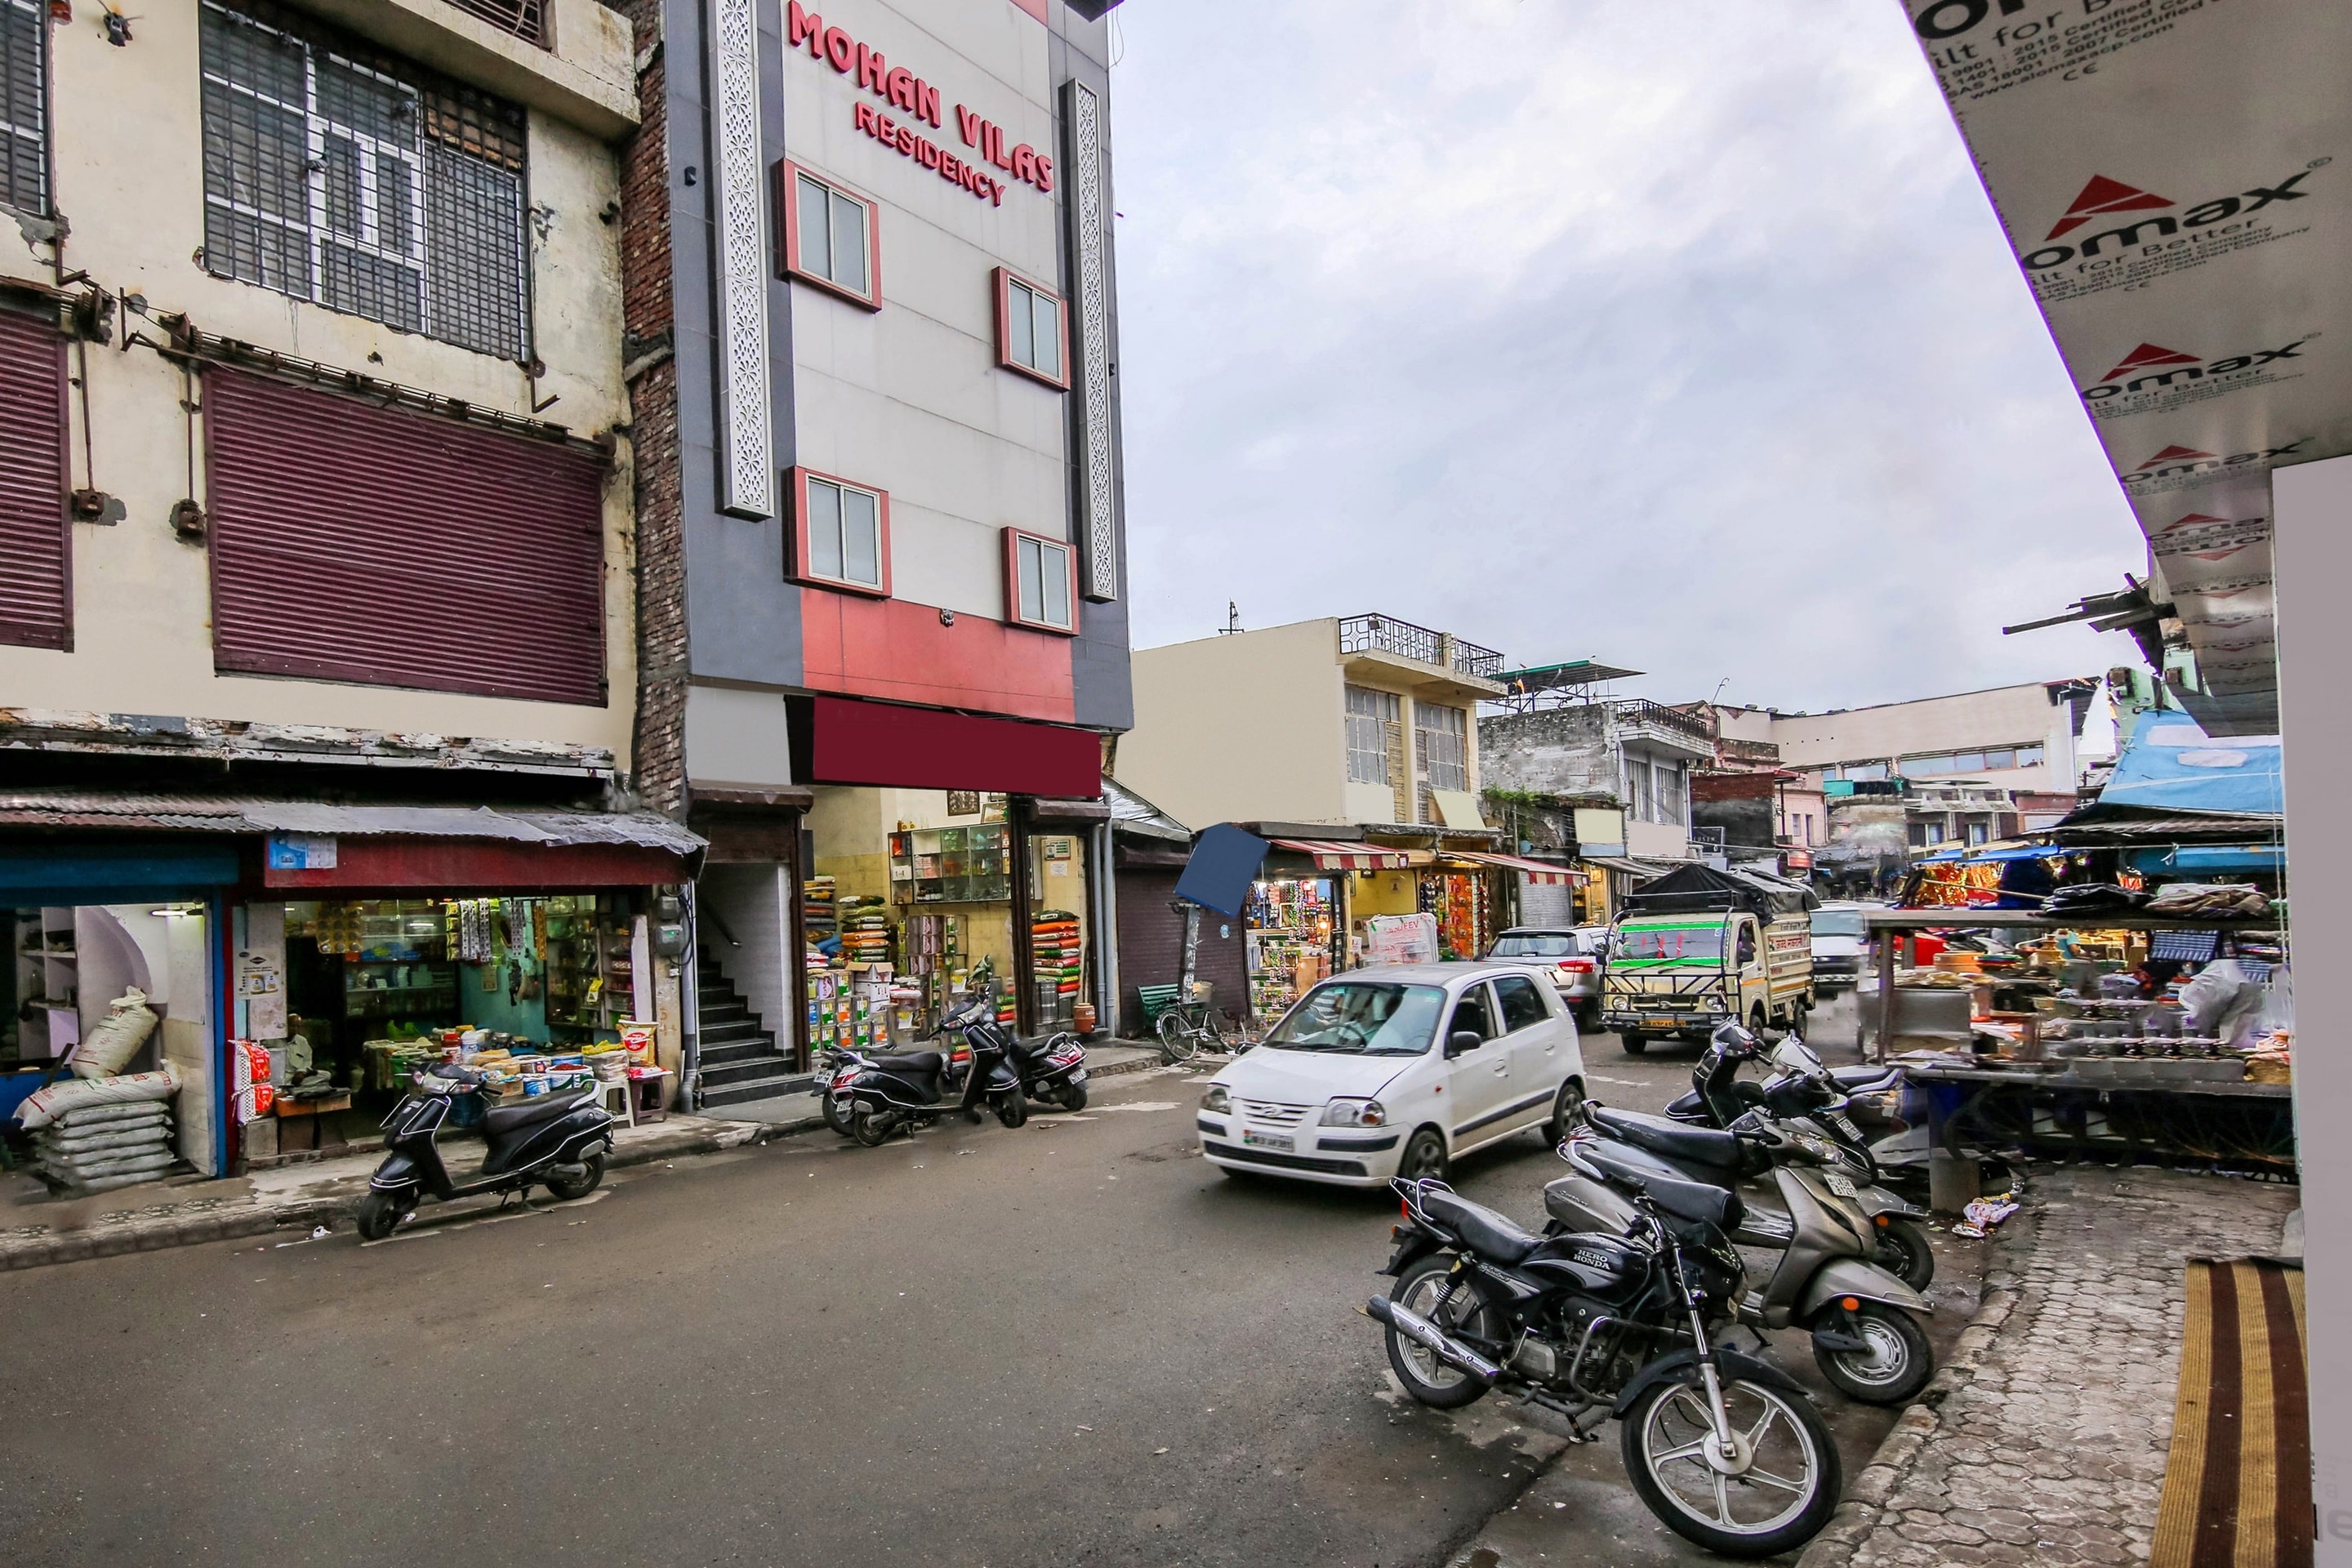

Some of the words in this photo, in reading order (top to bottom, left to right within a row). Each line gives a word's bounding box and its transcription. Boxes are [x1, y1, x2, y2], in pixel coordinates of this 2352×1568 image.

[1992, 11, 2063, 47] for
[2067, 8, 2153, 46] Certified
[2115, 0, 2203, 38] Certified
[789, 0, 941, 129] MOHAN
[956, 103, 1054, 193] VILAS
[855, 100, 1007, 207] RESIDENCY
[2022, 171, 2311, 270] omax
[2077, 254, 2127, 274] for
[2142, 218, 2260, 257] Better
[2082, 341, 2305, 400] omax
[1573, 1254, 1611, 1270] HONDA
[1578, 1249, 1608, 1263] HERO
